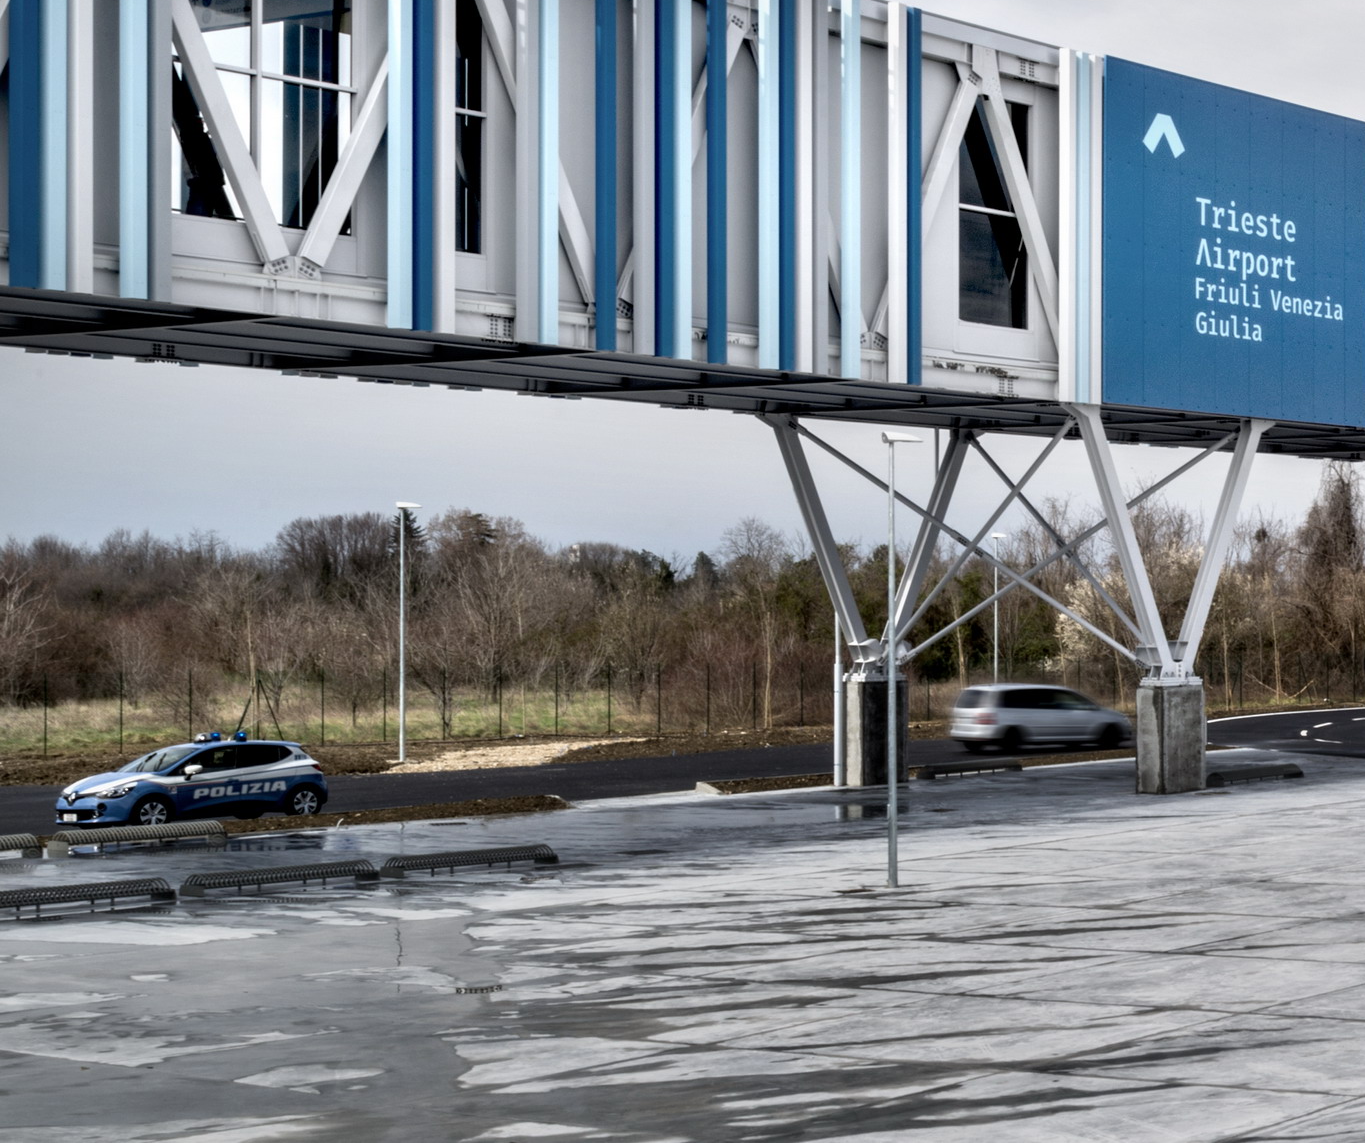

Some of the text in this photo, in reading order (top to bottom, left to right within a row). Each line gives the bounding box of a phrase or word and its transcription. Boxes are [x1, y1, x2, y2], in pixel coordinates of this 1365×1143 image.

[1195, 197, 1297, 243] Trieste
[1195, 238, 1297, 282] Airport
[1195, 277, 1344, 321] Friuli Venezia
[1195, 311, 1263, 342] Giulia
[192, 780, 287, 799] POLIZIA
